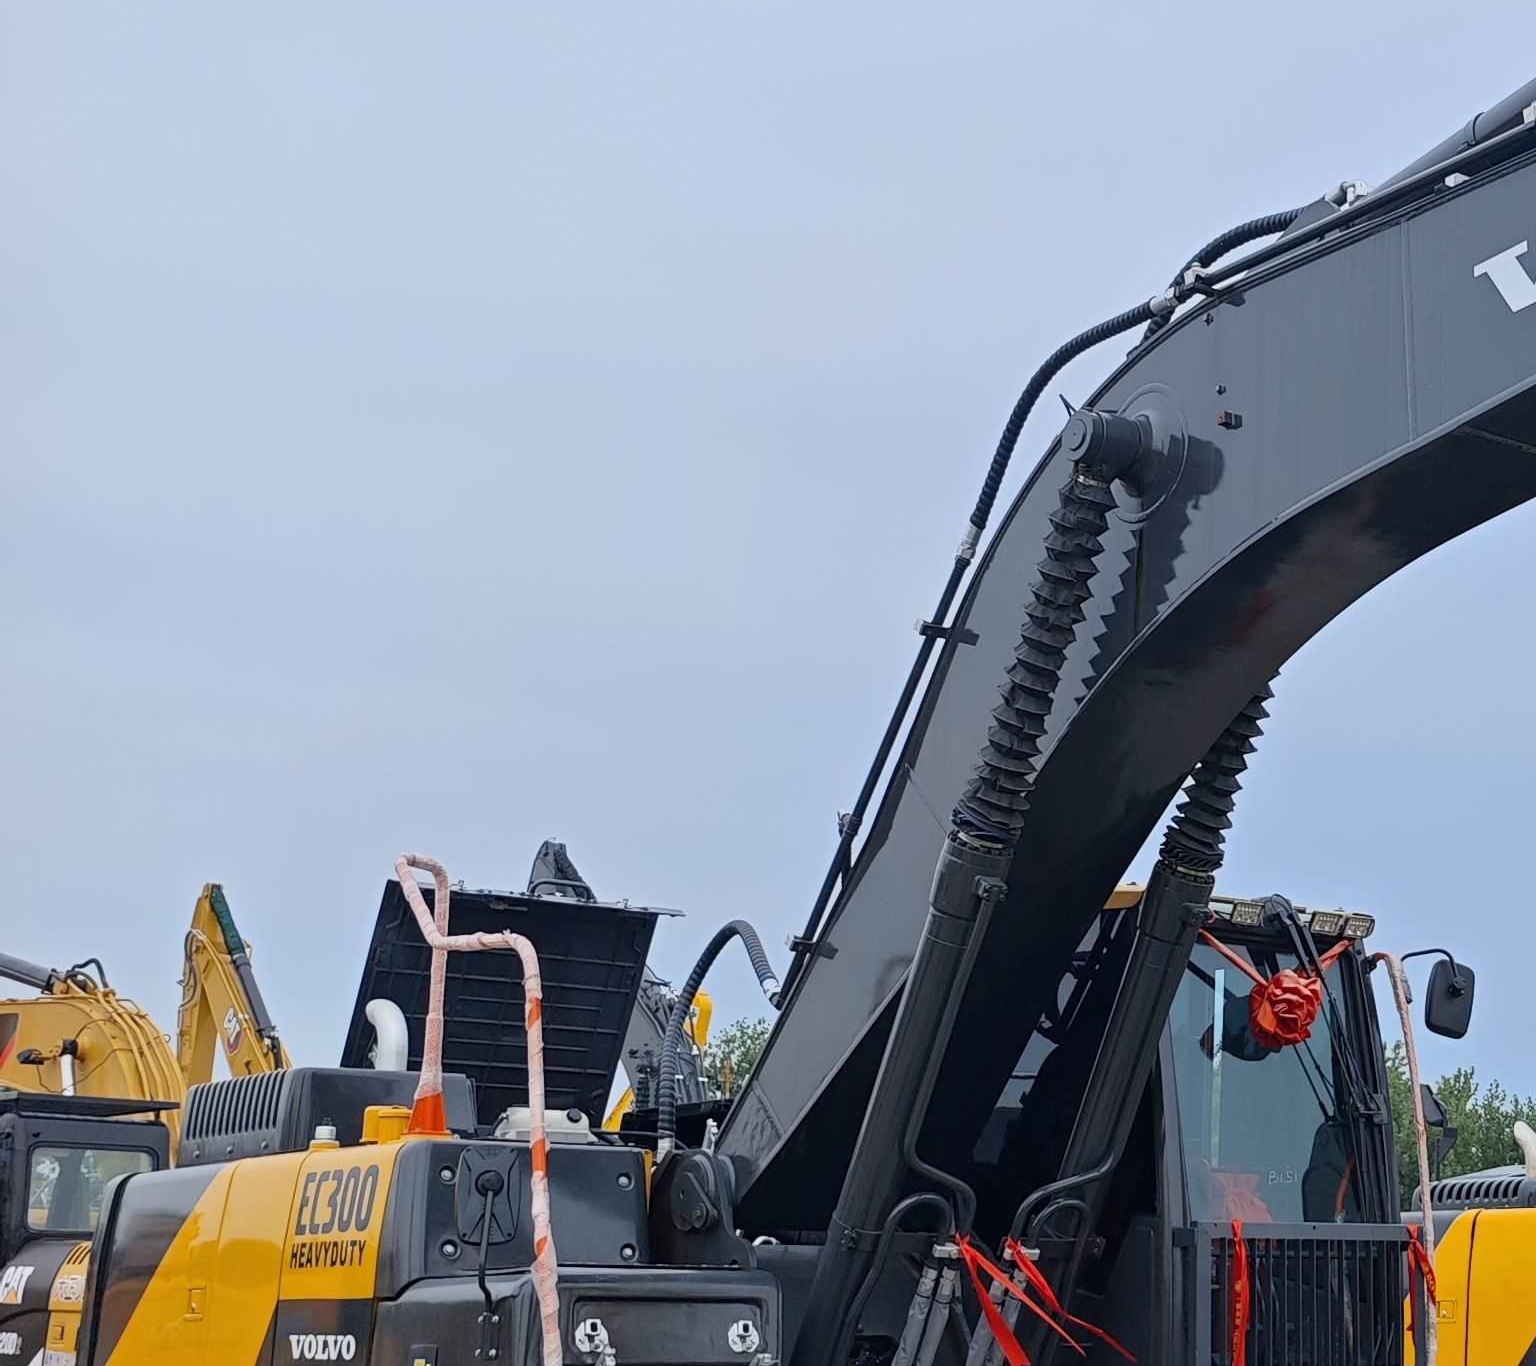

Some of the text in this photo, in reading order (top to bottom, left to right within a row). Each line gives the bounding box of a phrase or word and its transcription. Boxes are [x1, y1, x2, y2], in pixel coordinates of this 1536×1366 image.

[294, 1163, 380, 1236] EC300
[0, 1265, 36, 1305] CAT
[288, 1333, 357, 1361] VOLVO
